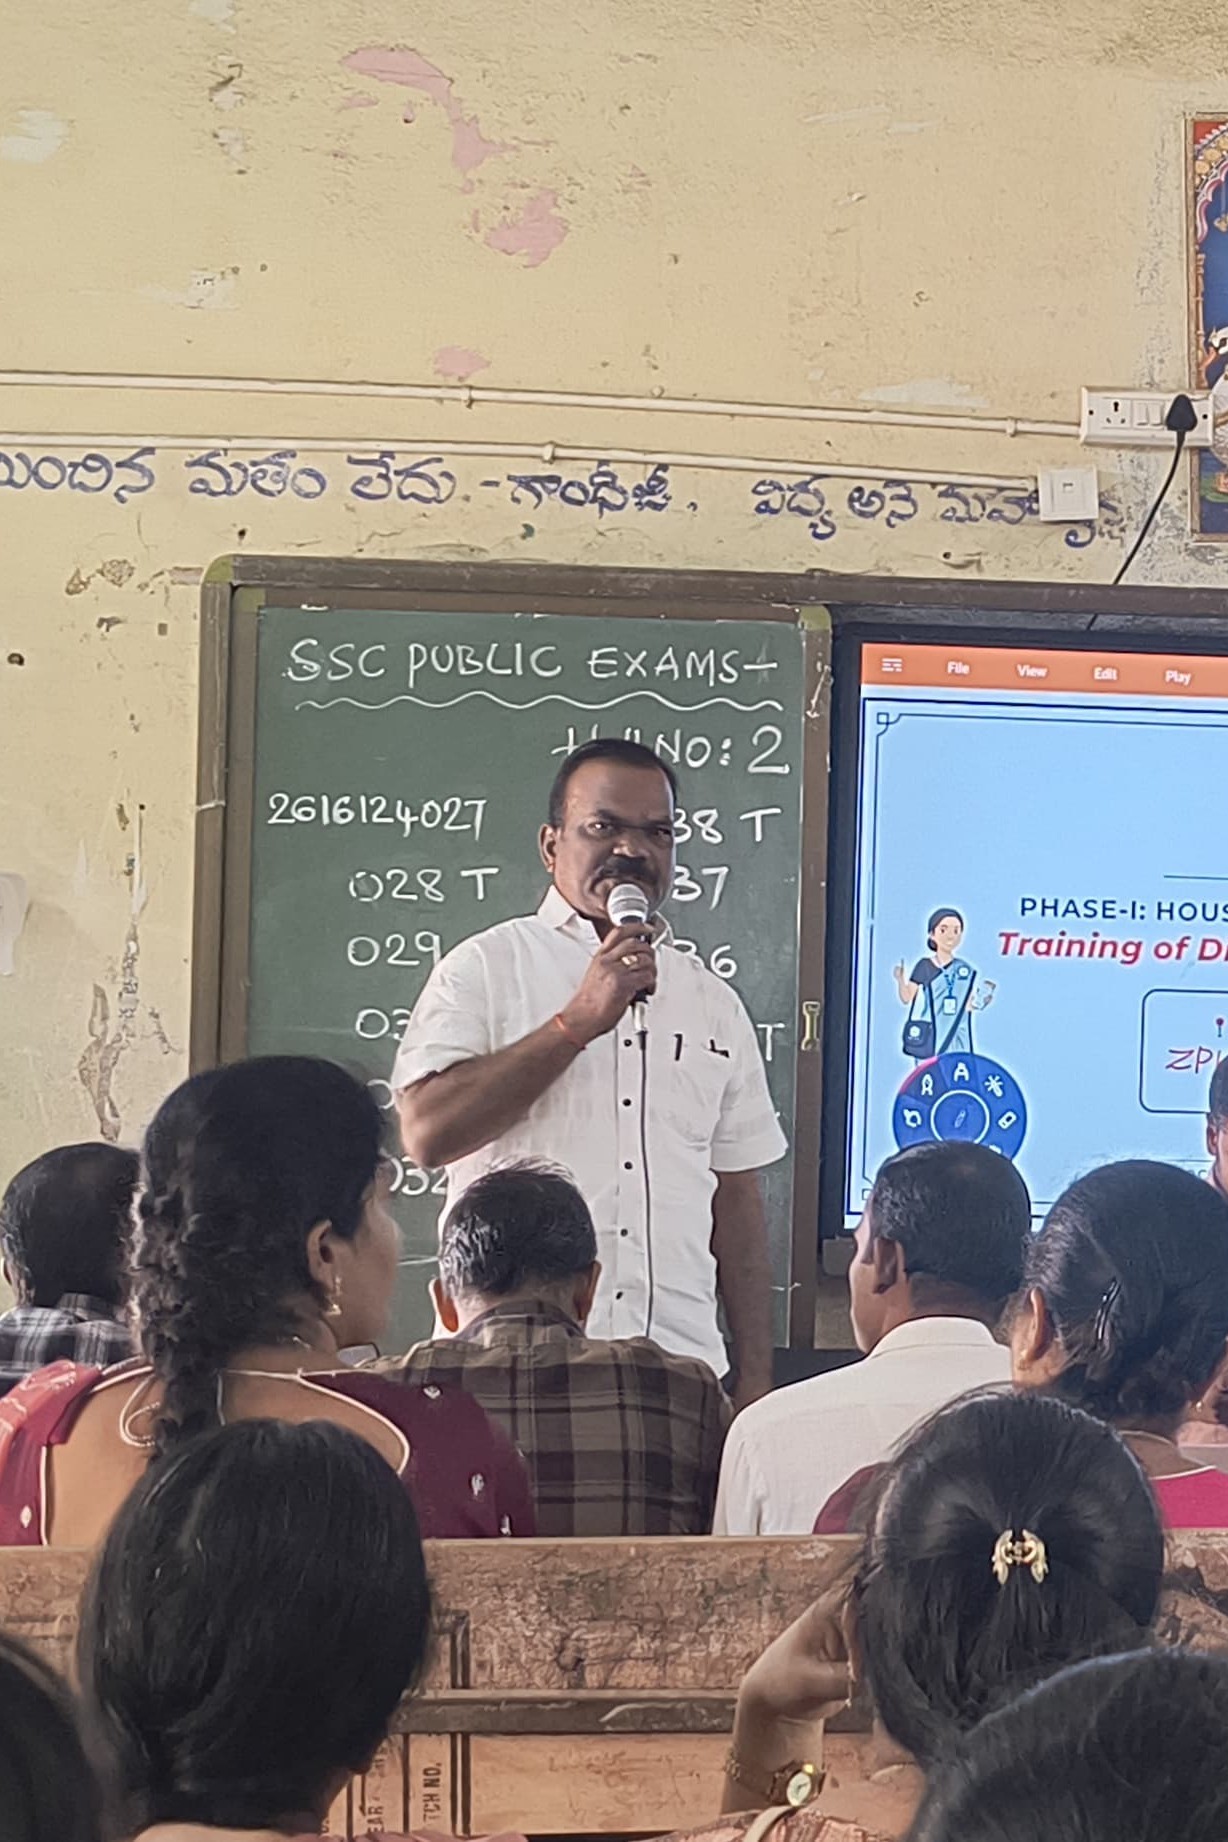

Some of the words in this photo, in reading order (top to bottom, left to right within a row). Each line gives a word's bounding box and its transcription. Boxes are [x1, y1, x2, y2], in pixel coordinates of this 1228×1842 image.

[283, 638, 387, 682] SSC
[408, 642, 562, 689] PUBLIC
[947, 661, 970, 675] File
[1016, 664, 1048, 678] View
[1094, 667, 1118, 681] Edit
[1165, 669, 1191, 686] Play
[747, 725, 791, 774] 2
[268, 792, 488, 842] 2616124027
[673, 808, 724, 844] 38
[740, 808, 782, 842] T
[350, 868, 445, 902] 028
[672, 865, 729, 911] 37
[1020, 897, 1146, 921] PHASE-I:
[348, 931, 443, 967] 029
[998, 930, 1143, 966] Training
[1153, 935, 1191, 961] of
[355, 1008, 412, 1041] 03
[1165, 1046, 1222, 1074] ZP
